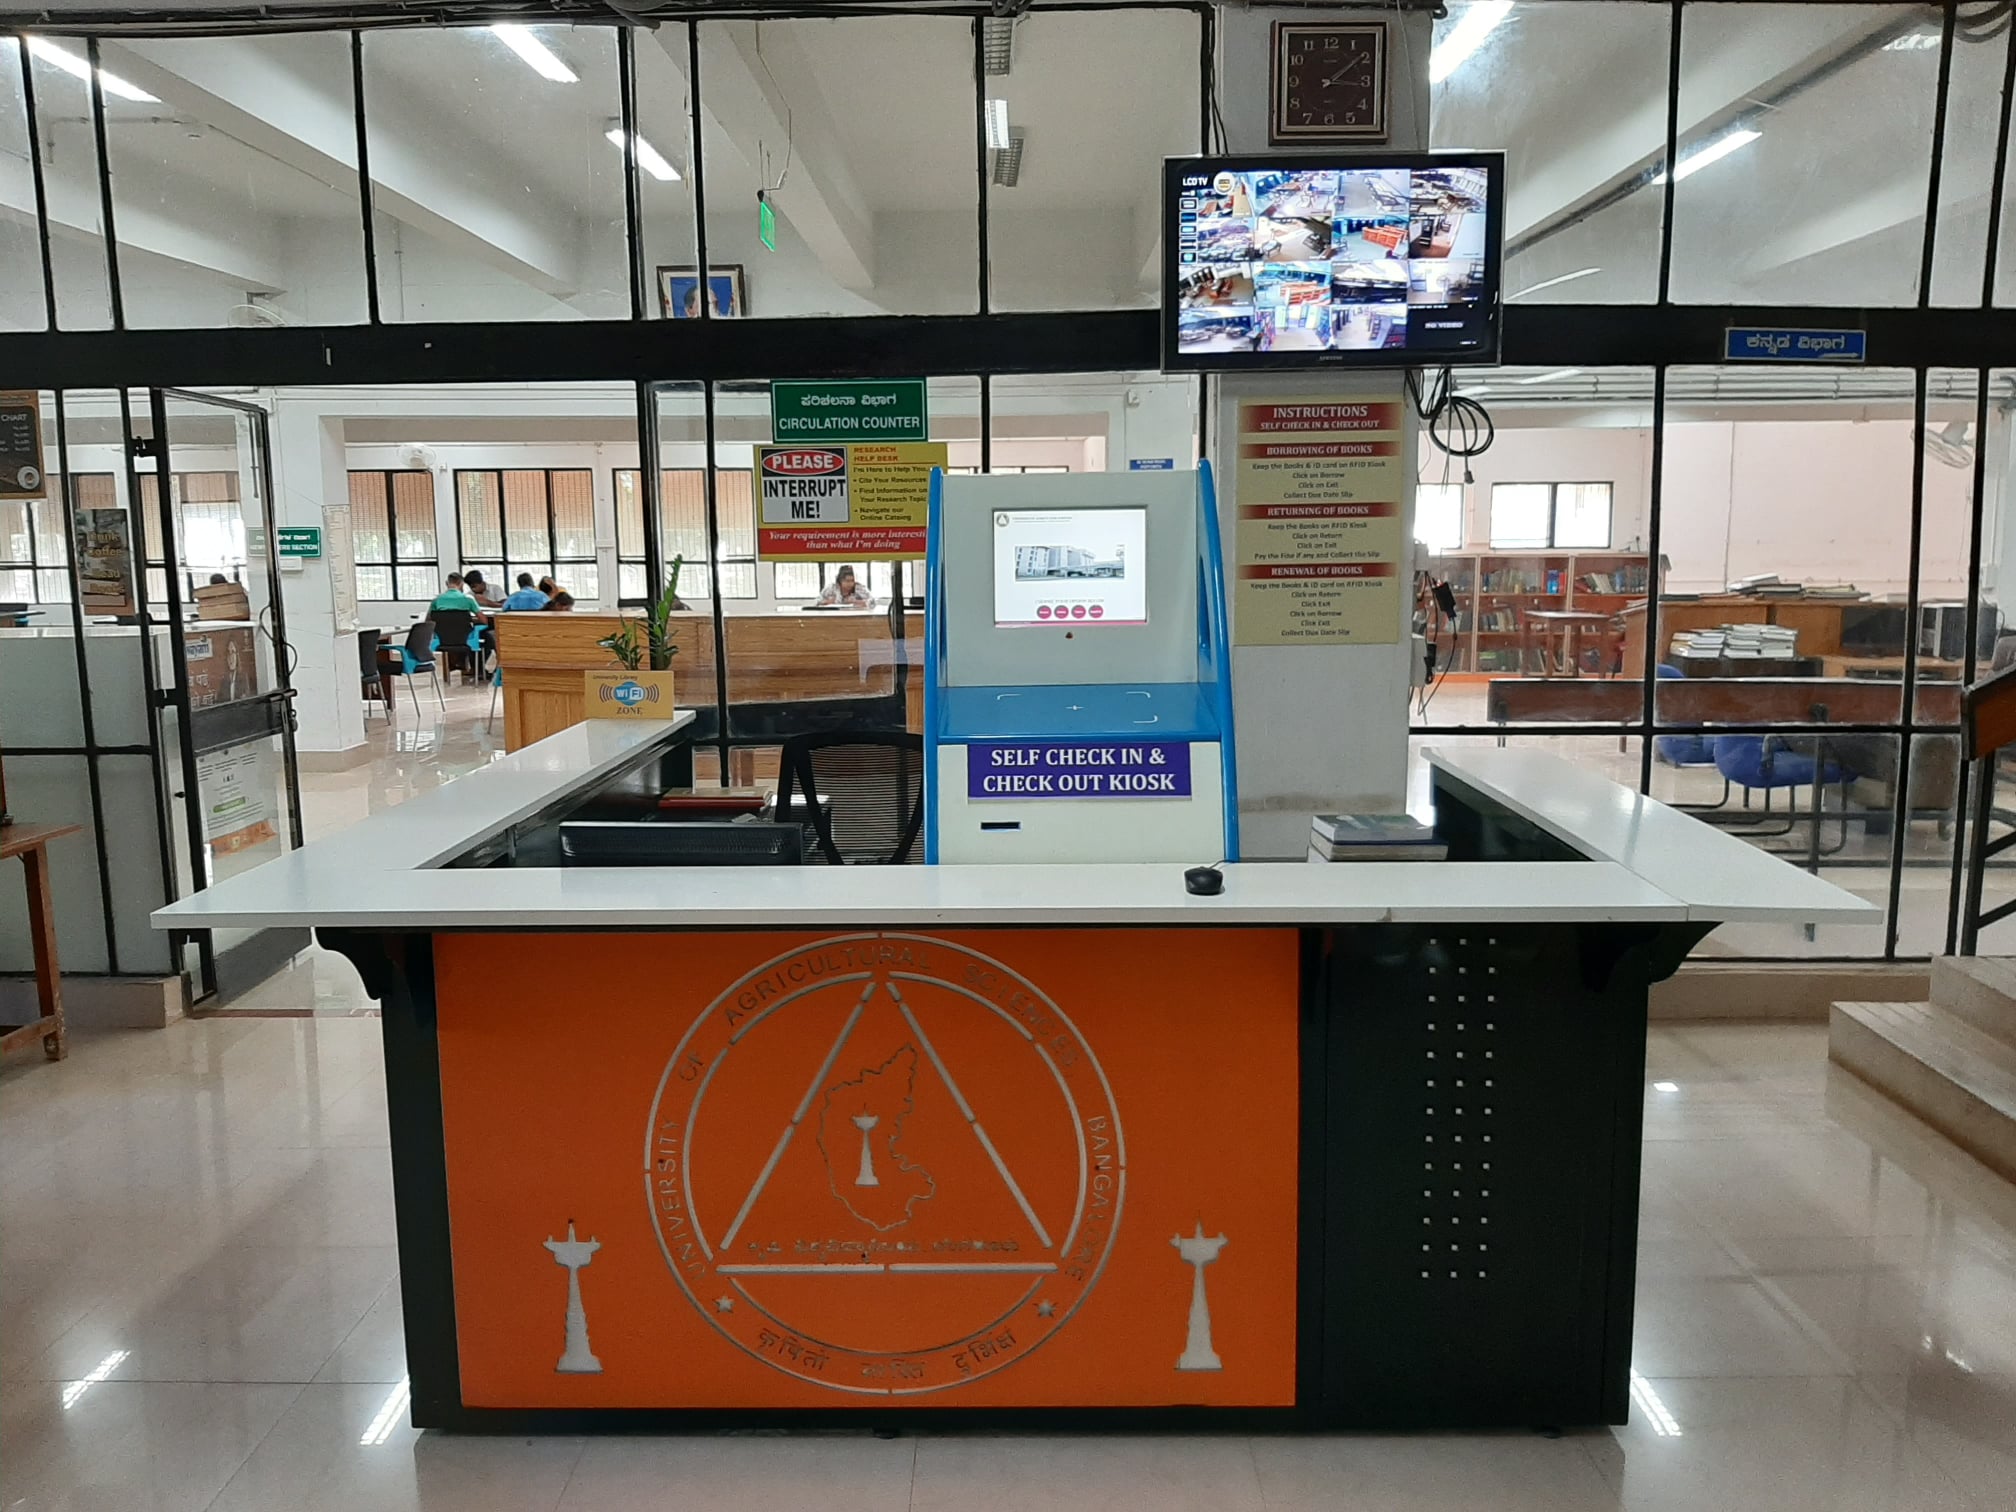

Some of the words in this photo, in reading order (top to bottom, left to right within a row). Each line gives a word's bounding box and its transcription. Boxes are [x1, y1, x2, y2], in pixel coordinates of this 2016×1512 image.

[1303, 40, 1314, 50] 11
[1324, 37, 1340, 49] 12
[1350, 40, 1356, 50] 1
[1290, 54, 1304, 66] 10
[1360, 51, 1370, 64] 2
[1289, 75, 1299, 87] 9
[1361, 75, 1371, 87] 3
[1289, 97, 1300, 109] 8
[1357, 98, 1368, 110] 4
[1303, 112, 1312, 124] 7
[1324, 113, 1335, 125] 6
[1345, 112, 1356, 124] 5
[1746, 333, 1791, 355] ಕನ್ನಡ
[861, 393, 897, 407] ವಿಭಾಗ
[1273, 405, 1369, 418] INSTRUCTIONS
[779, 417, 859, 430] CIRCULATION
[862, 416, 920, 429] COUNTER
[1260, 422, 1280, 430] SELF
[1282, 421, 1311, 430] CHECK
[1312, 421, 1321, 429] IN
[1323, 421, 1329, 429] &
[1331, 420, 1359, 429] CHECK
[1361, 420, 1379, 428] OUT
[1266, 446, 1325, 455] BORROWING
[1326, 445, 1340, 454] OF
[1341, 445, 1373, 454] BOOKS
[772, 455, 834, 469] PLEASE
[763, 479, 846, 497] INTERRUPT
[791, 500, 820, 519] ME!
[1267, 507, 1321, 516] RETURNING
[1323, 507, 1335, 515] OF
[1337, 506, 1369, 514] BOOKS
[769, 531, 791, 540] Your
[793, 531, 850, 542] requirement
[851, 530, 859, 538] is
[862, 531, 886, 539] more
[888, 529, 927, 539] interesti
[806, 541, 828, 549] than
[830, 540, 853, 549] what
[874, 539, 900, 549] doing
[1271, 567, 1315, 576] RENEWAL
[1317, 567, 1329, 575] OF
[1331, 566, 1363, 575] BOOKS
[616, 706, 643, 715] ZONE
[991, 749, 1041, 766] SELF
[1045, 748, 1116, 766] CHECK
[1121, 748, 1143, 765] IN
[1148, 747, 1166, 765] &
[983, 775, 1053, 792] CHECK
[1058, 774, 1104, 791] OUT
[1109, 773, 1176, 791] KIOSK
[724, 945, 932, 1027] AGRICULTURAL
[679, 1051, 704, 1082] OF
[657, 1112, 706, 1281] UNIVERSITY
